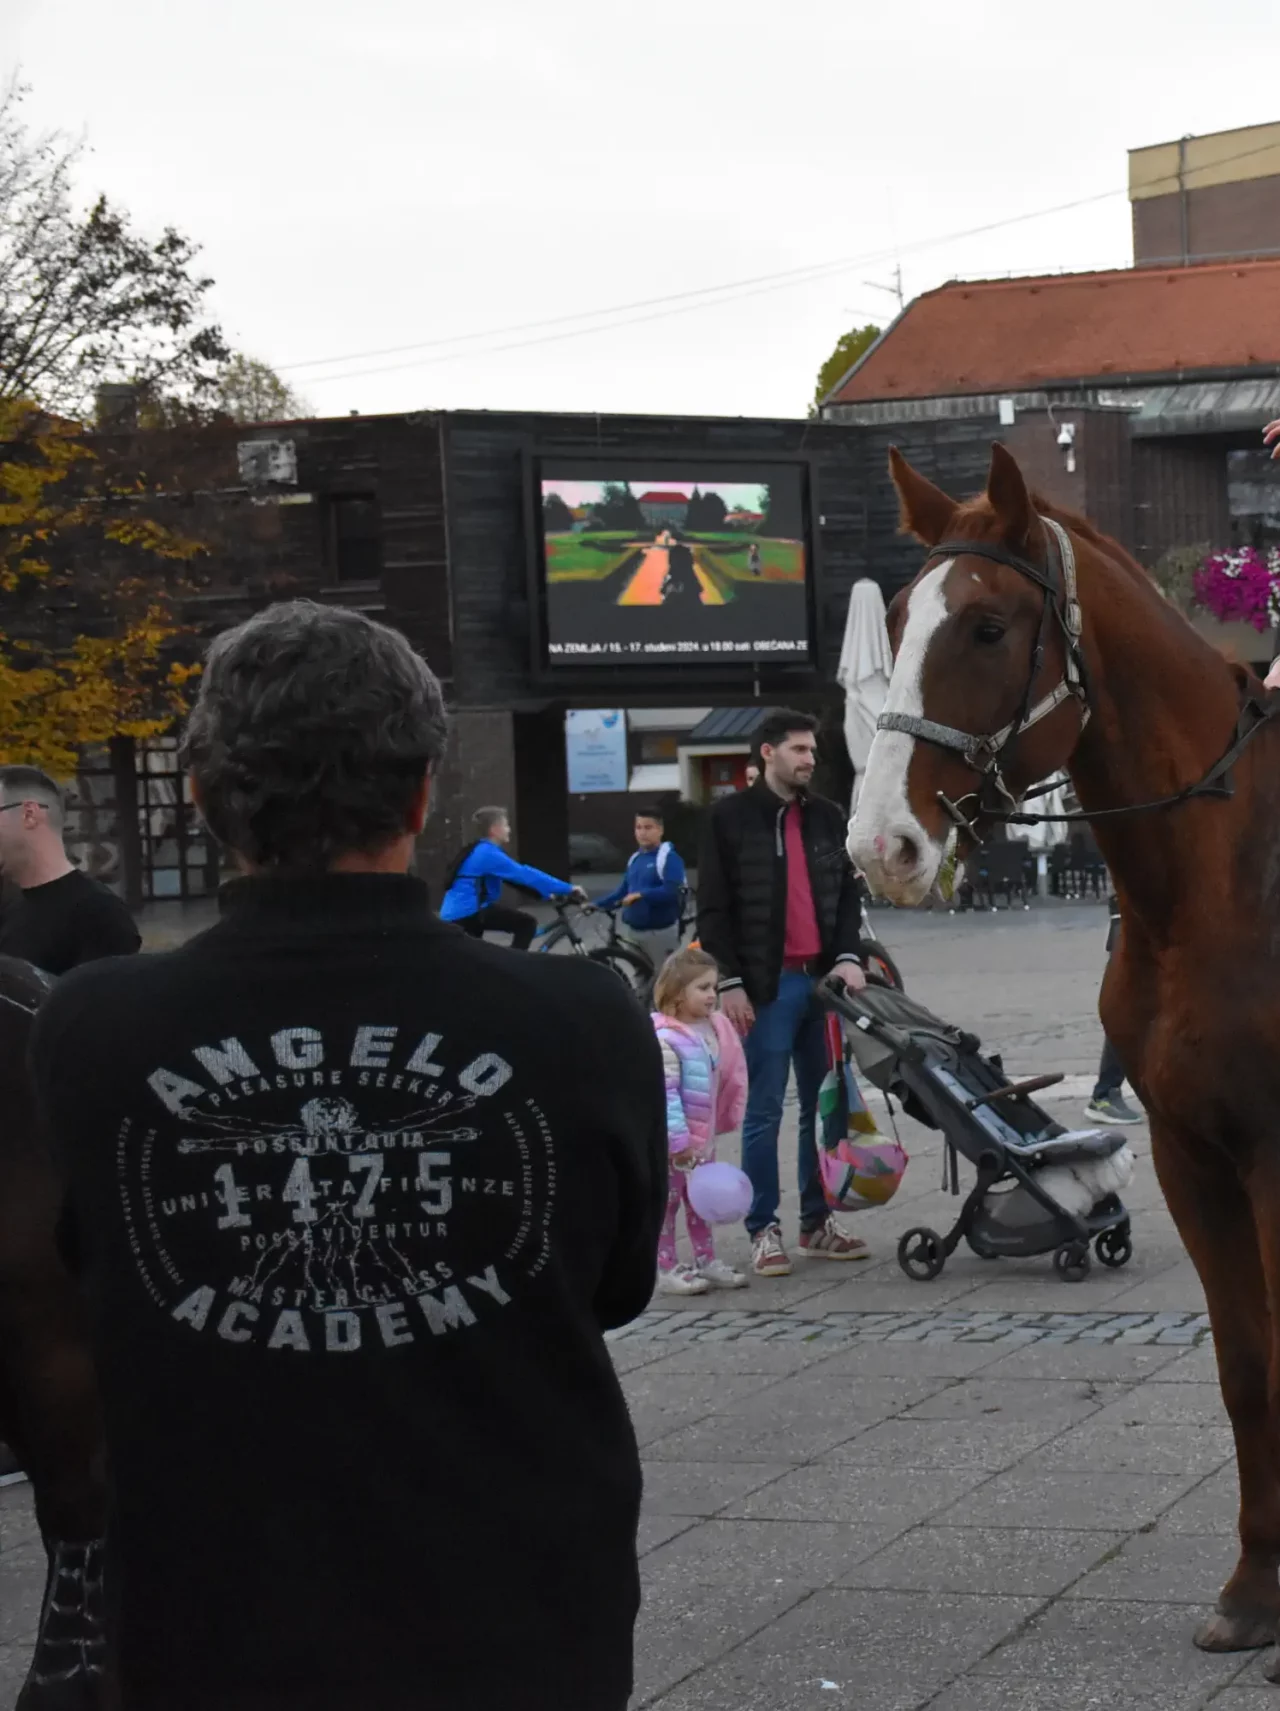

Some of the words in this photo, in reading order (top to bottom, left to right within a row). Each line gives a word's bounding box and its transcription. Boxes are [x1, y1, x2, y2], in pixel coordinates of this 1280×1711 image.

[146, 1025, 514, 1115] ANGELO
[208, 1070, 343, 1107] PLEASURE
[357, 1071, 454, 1105] SEEKER
[322, 1222, 448, 1244] VIDENTUR
[172, 1264, 512, 1352] ACADEMY
